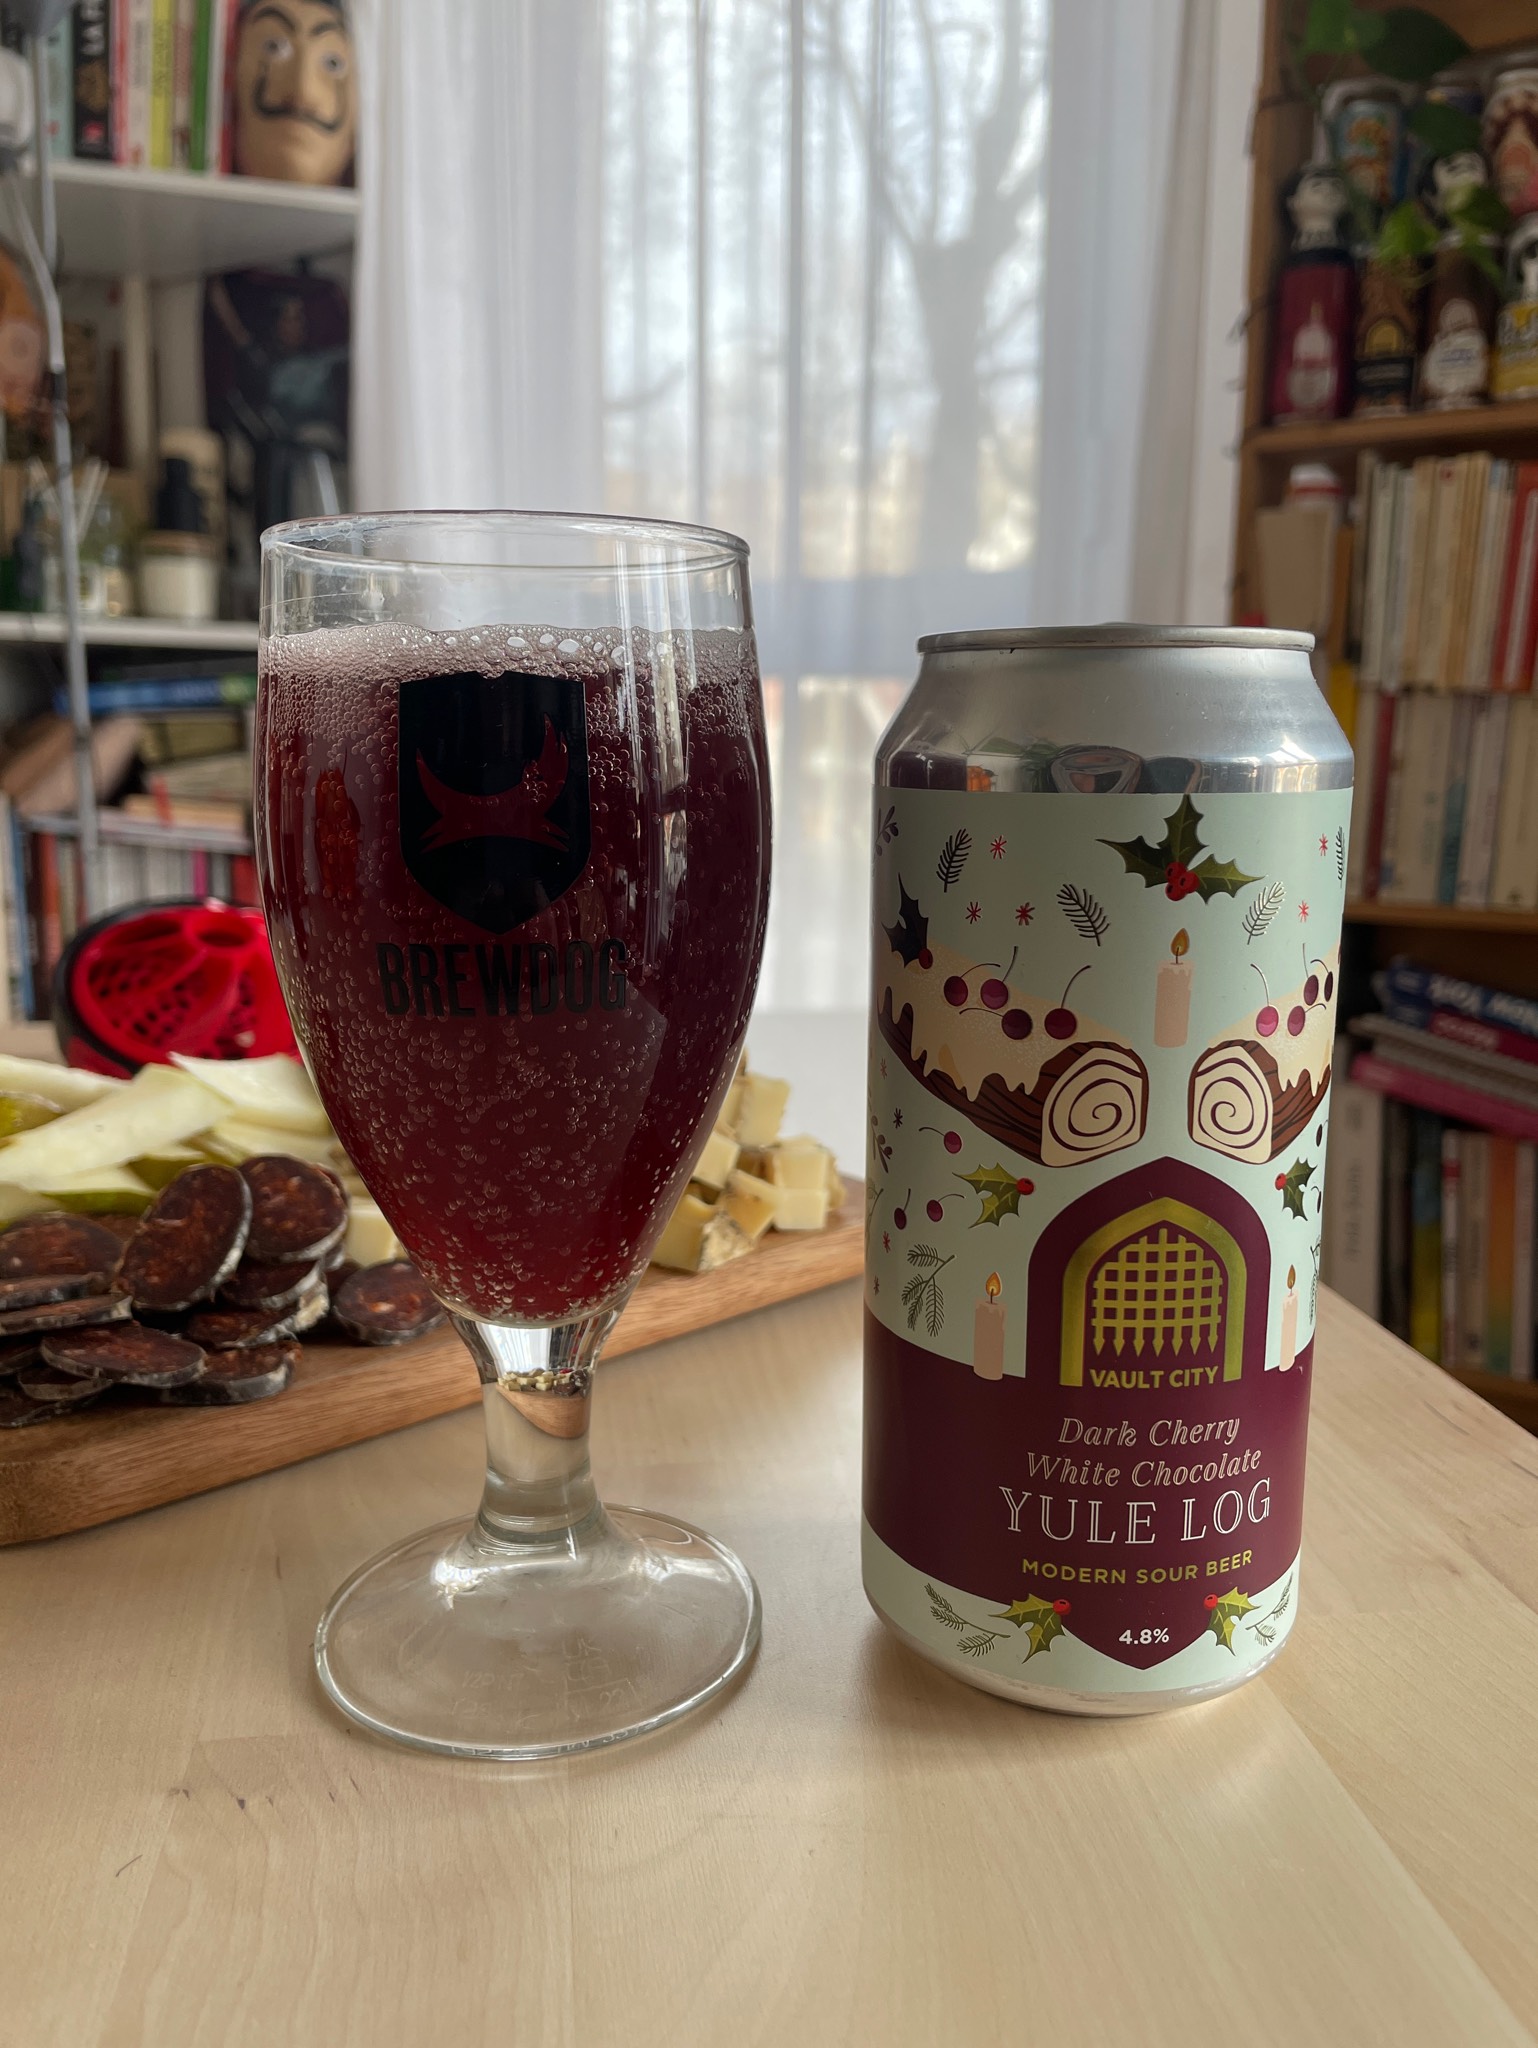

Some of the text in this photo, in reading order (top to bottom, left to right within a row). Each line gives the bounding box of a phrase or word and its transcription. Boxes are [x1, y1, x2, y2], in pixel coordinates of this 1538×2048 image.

[376, 938, 627, 1017] BREWDOG
[1089, 1365, 1219, 1389] VAULT CITY
[1058, 1417, 1240, 1447] Dark Cherry
[1027, 1448, 1262, 1487] White Chocolate
[999, 1477, 1271, 1544] YULE LOG
[1022, 1549, 1253, 1584] MODERN SOUR BEER
[1118, 1628, 1170, 1645] 4.8%
